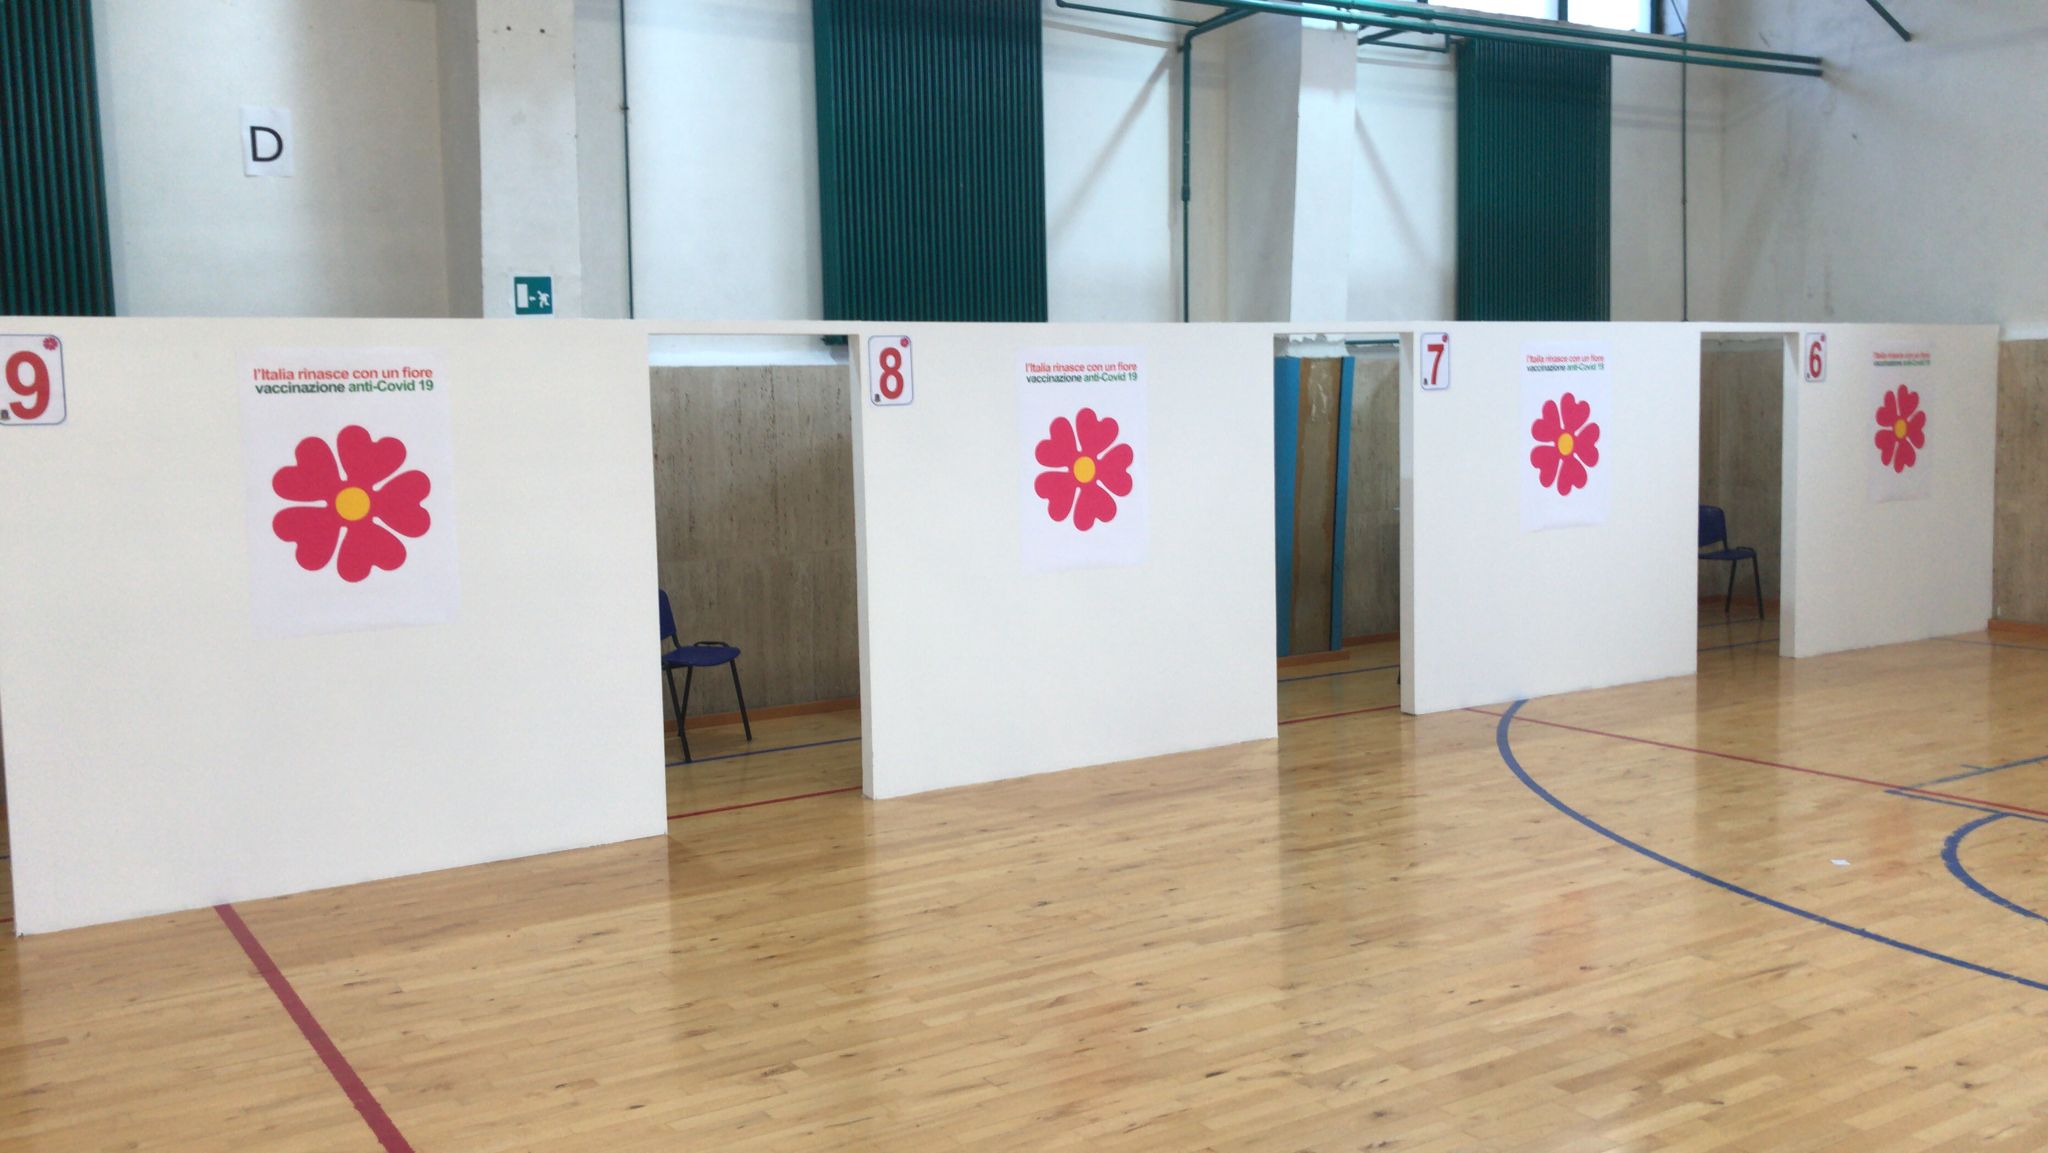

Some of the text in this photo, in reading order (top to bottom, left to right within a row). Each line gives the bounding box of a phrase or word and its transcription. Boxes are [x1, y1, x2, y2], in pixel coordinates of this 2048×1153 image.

[250, 126, 283, 162] D
[253, 366, 433, 381] l'Italia rinasce con un fiore
[879, 347, 904, 400] 8
[1026, 372, 1138, 383] vaccinazione anti-Covid 19
[1053, 363, 1085, 372] rinasce
[1105, 363, 1116, 371] un
[1118, 362, 1137, 371] fiore
[1427, 344, 1444, 385] 7
[1809, 341, 1822, 378] 6
[5, 350, 50, 420] 9
[255, 379, 434, 394] vaccinazione anti-Covid 19
